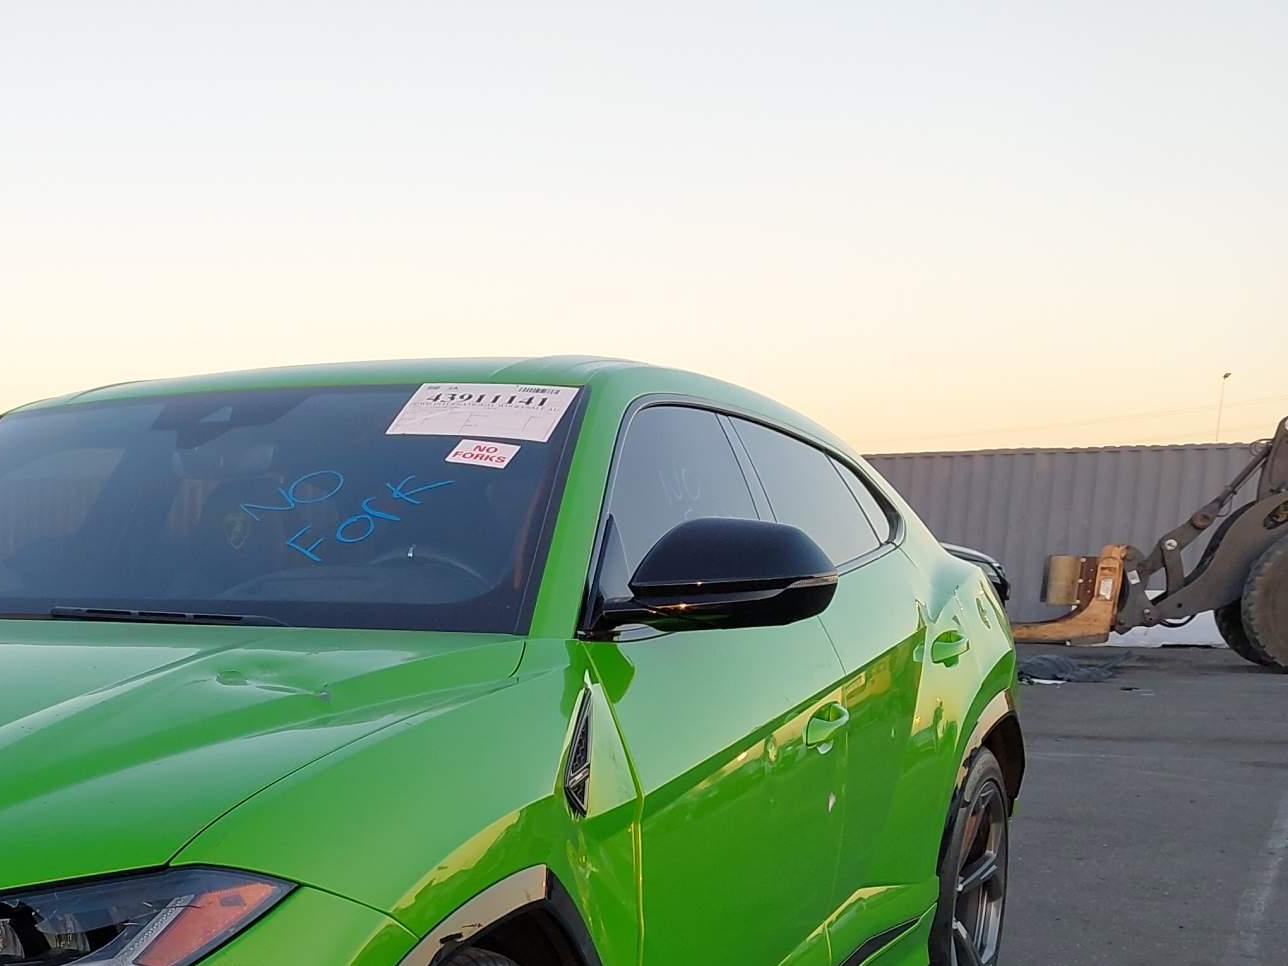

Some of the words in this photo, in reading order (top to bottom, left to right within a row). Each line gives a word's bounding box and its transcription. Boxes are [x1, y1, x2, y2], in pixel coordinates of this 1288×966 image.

[427, 393, 548, 407] 43911141
[473, 445, 498, 454] NO
[452, 451, 506, 463] FORKS
[240, 470, 344, 520] NO
